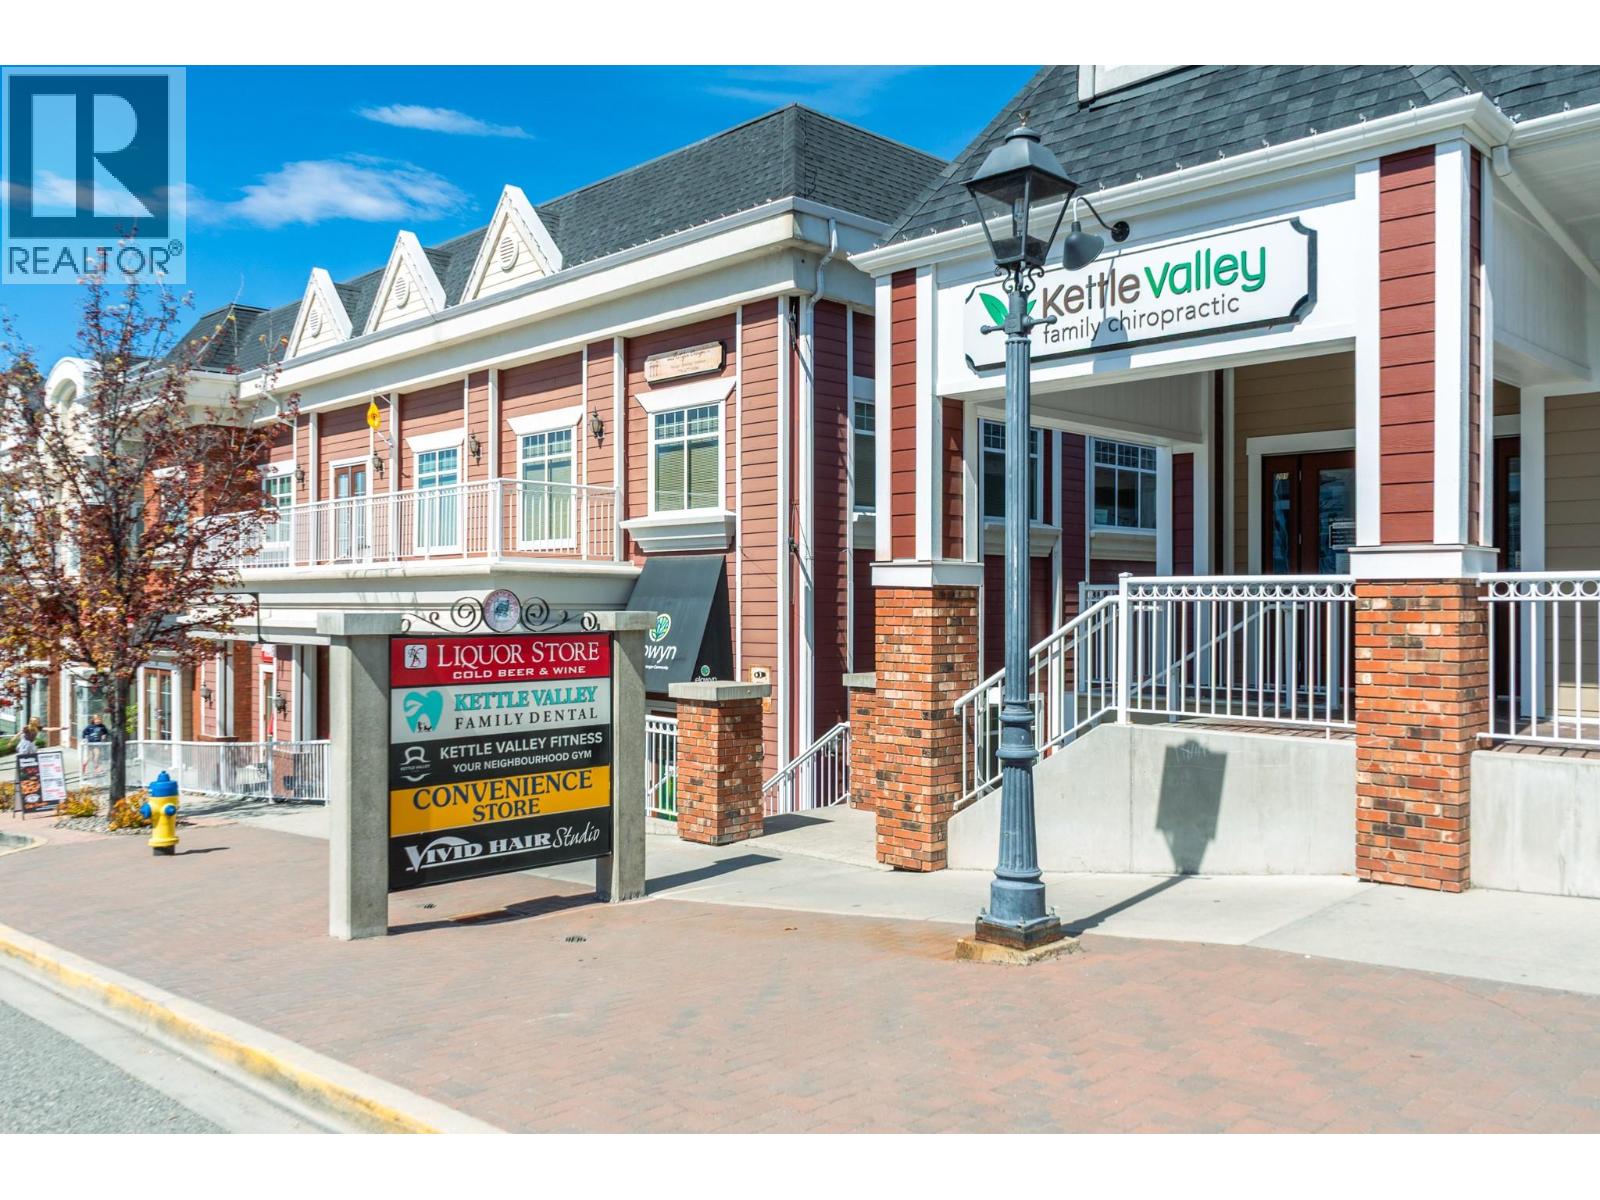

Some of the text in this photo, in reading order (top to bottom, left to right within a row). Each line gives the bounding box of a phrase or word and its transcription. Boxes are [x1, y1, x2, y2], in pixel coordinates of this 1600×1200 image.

[1043, 293, 1240, 345] family chiropractic
[437, 641, 600, 670] LIQUOR STORE
[453, 666, 586, 680] COLD BEER & WINE
[454, 685, 598, 712] KETTLE VALLEY
[455, 707, 598, 730] FAMILY DENTAL
[440, 732, 603, 760] KETTLE VALLEY FITNESS
[453, 750, 592, 773] YOUR NEIGHBOURHOOD GYM
[412, 769, 593, 811] CONVENIENCE
[472, 798, 541, 823] STORE
[404, 821, 601, 873] VIVID HAIR Studio
